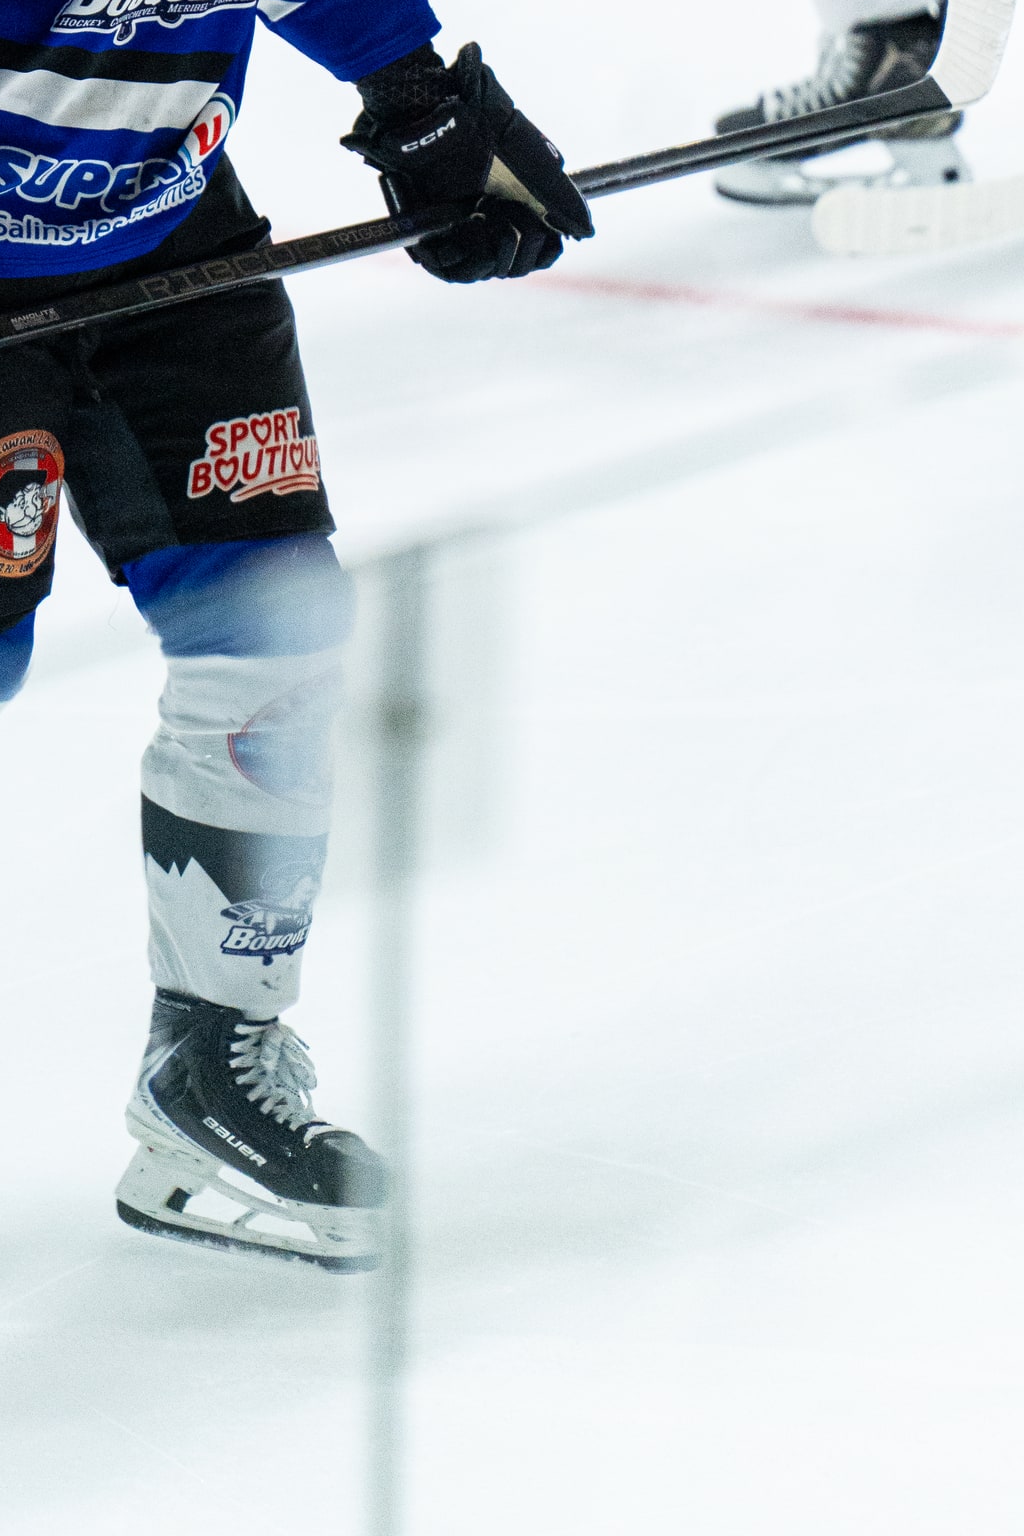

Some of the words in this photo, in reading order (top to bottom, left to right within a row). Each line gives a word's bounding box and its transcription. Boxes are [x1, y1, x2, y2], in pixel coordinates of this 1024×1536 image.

[59, 17, 105, 27] HOCKEY
[167, 1, 210, 14] MERIBEL
[193, 112, 223, 157] U
[401, 117, 456, 153] CCM
[209, 410, 298, 457] SPORT
[202, 1116, 268, 1168] BAUER
